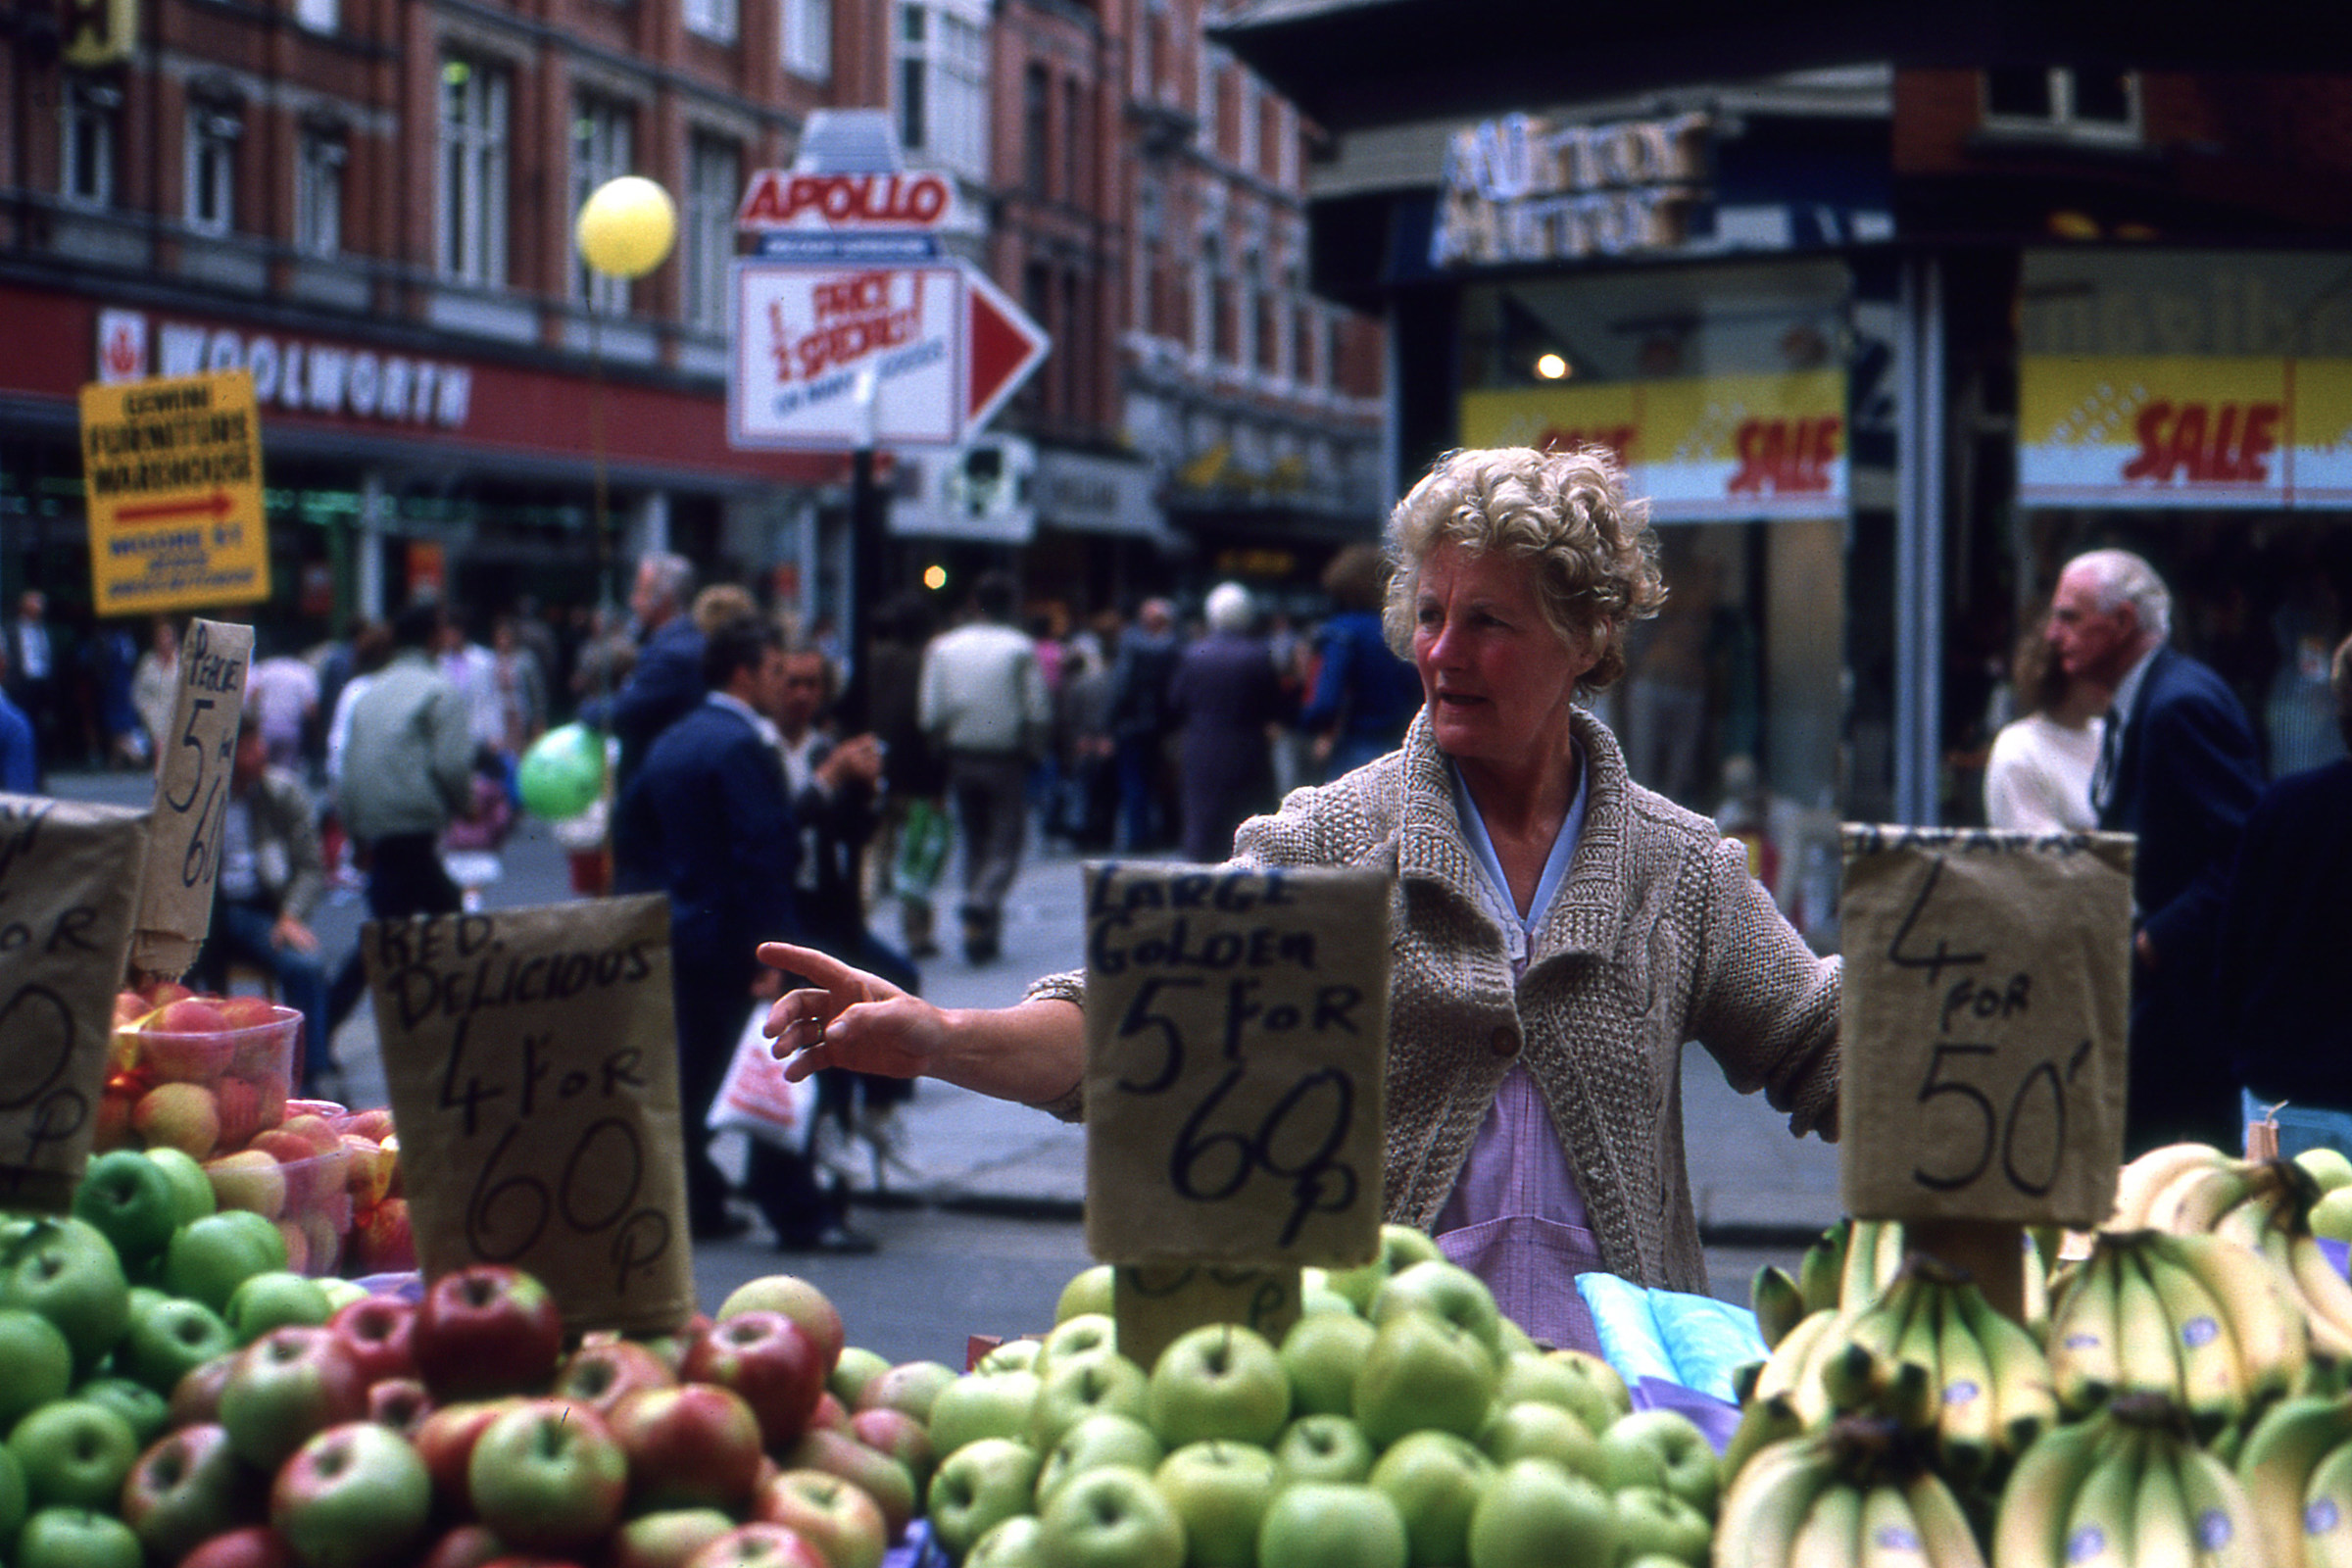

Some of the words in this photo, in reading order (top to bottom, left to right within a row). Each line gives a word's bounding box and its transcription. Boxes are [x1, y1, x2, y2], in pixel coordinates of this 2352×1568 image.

[740, 172, 948, 224] APOLLO
[159, 321, 472, 427] WOOLWORTH
[89, 412, 249, 459] FURNITURE
[92, 451, 254, 497] WAREHOUSE
[1728, 415, 1841, 494] SALE
[2121, 401, 2279, 482] SALE
[165, 699, 215, 813] 5
[1089, 862, 1296, 916] LARGE
[1887, 855, 1985, 986] 4
[388, 939, 653, 1031] DELICIOUS
[438, 1017, 504, 1136] 4
[1116, 976, 1206, 1095] 5
